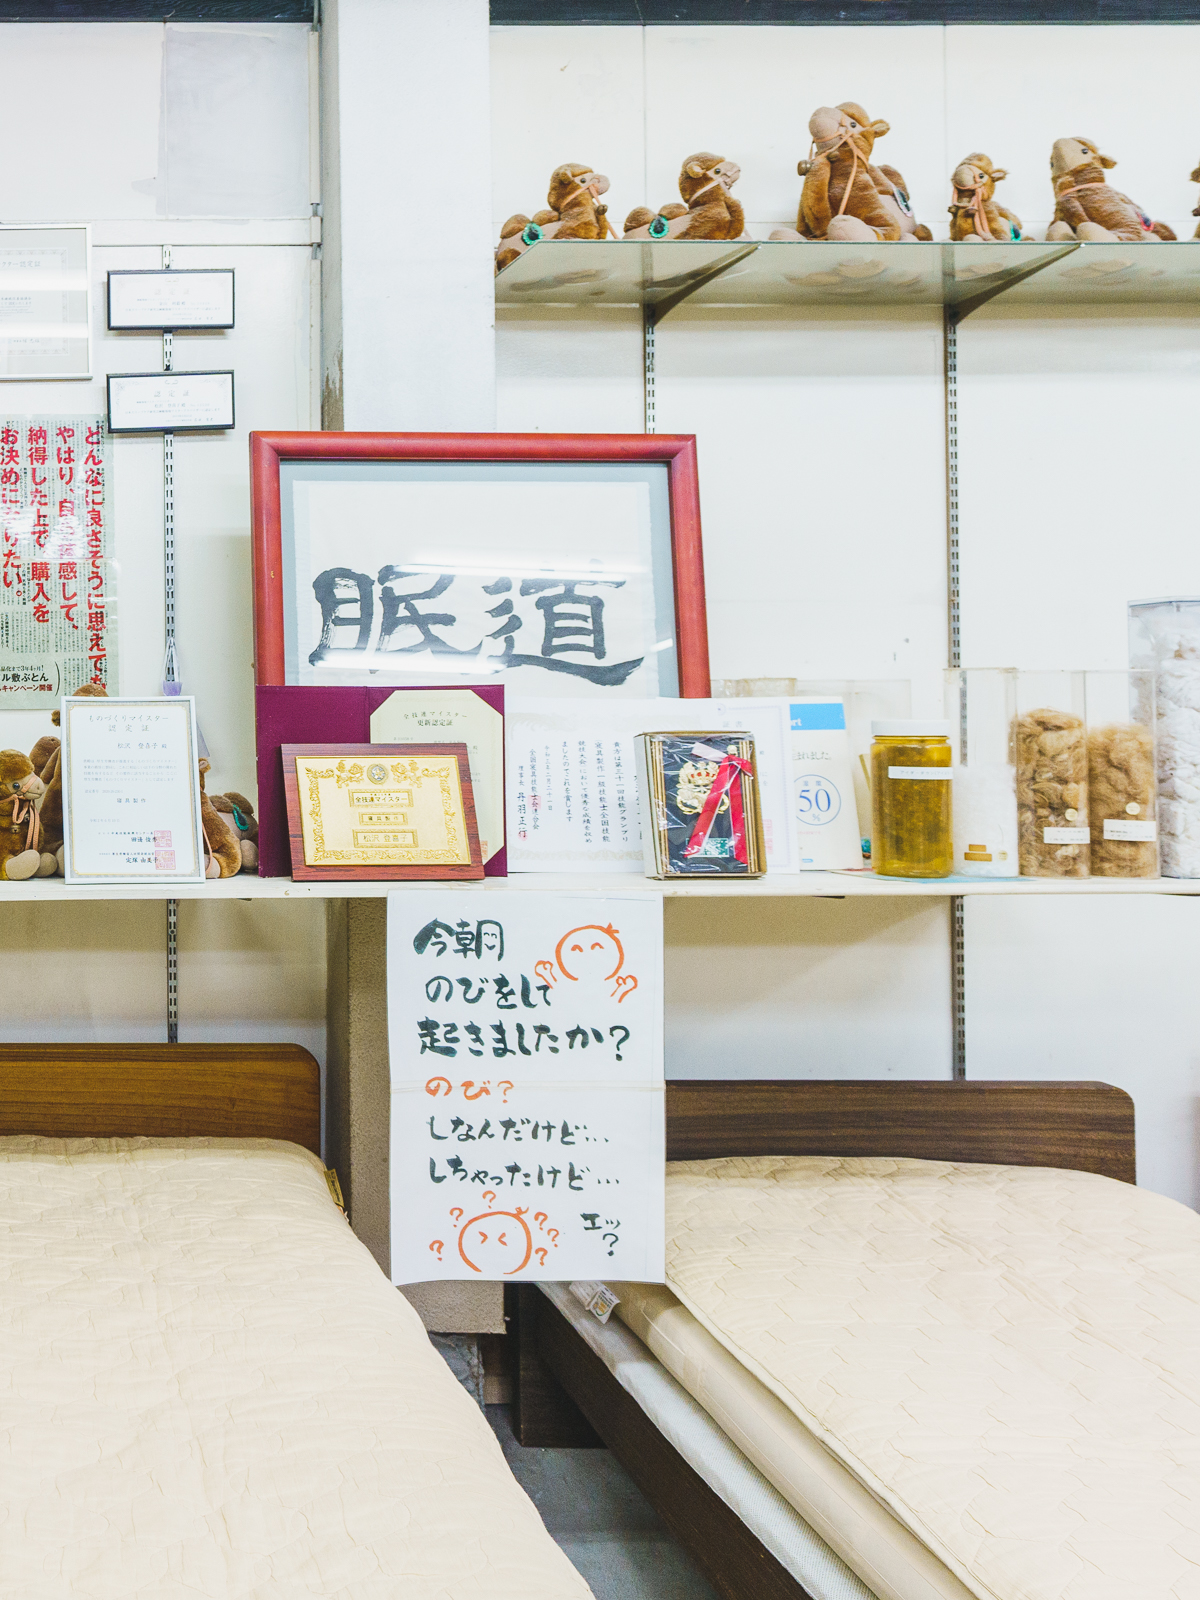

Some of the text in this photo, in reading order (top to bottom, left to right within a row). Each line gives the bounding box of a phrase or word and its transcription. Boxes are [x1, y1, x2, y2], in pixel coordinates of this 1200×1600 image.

[55, 426, 79, 630] やはり、自感して、
[308, 562, 644, 686] 眠道
[799, 788, 831, 813] 50
[412, 918, 504, 961] 今朝
[426, 973, 552, 1009] のびをして
[417, 1016, 631, 1062] 起きましたか？
[425, 1076, 514, 1103] のび？
